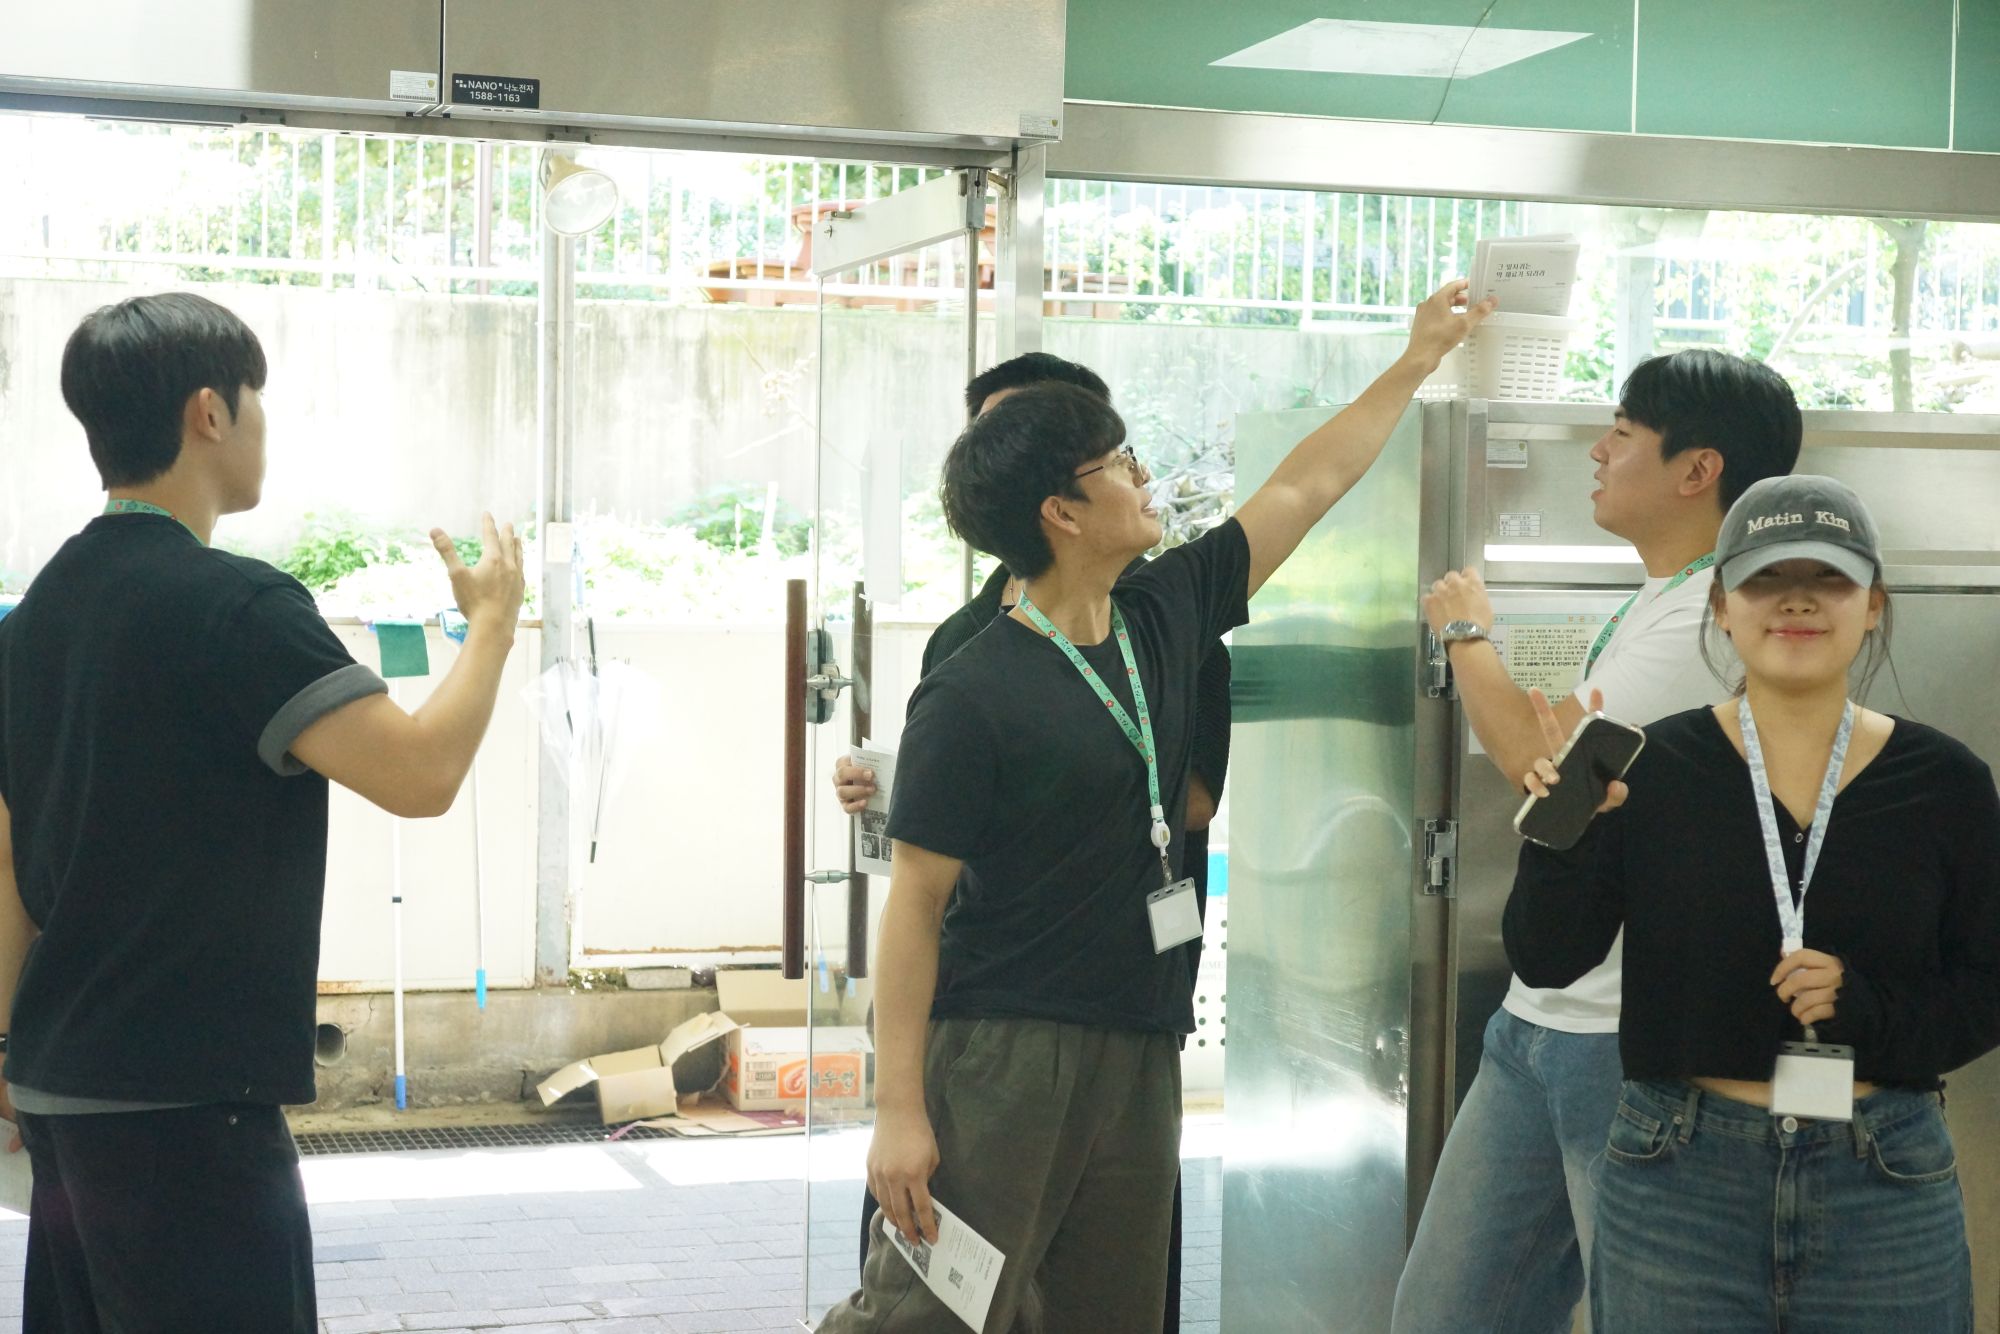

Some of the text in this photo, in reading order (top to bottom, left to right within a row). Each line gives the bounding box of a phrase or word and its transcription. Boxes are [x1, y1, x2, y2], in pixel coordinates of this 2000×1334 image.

[467, 80, 534, 94] NANO 나노전자
[469, 91, 521, 103] 1588-1163
[1747, 510, 1851, 535] Matin Kim
